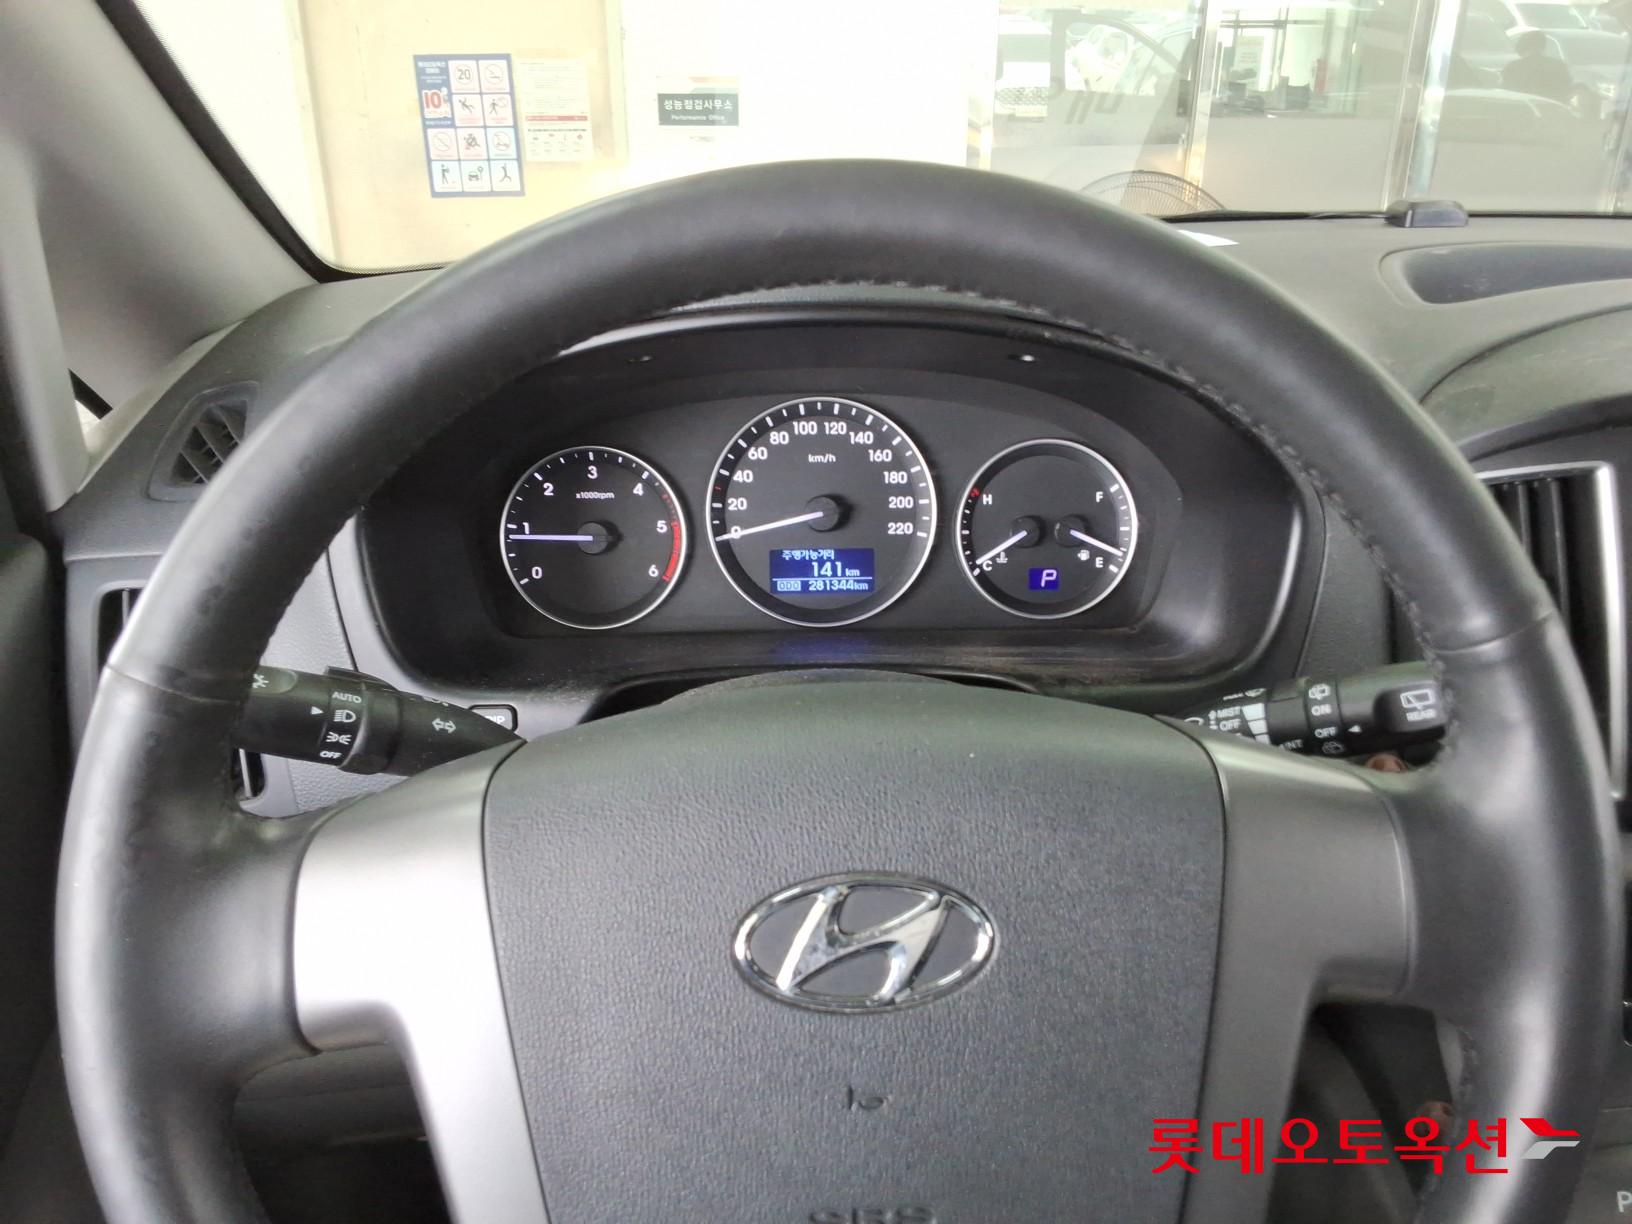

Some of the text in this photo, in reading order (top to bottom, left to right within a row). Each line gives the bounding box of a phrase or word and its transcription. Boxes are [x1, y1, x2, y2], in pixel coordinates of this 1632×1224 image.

[457, 69, 471, 80] 20
[663, 99, 733, 111] 성능점검사무소
[793, 421, 818, 435] 100
[824, 421, 847, 435] 120
[769, 431, 789, 445] 80
[849, 431, 874, 445] 140
[748, 449, 768, 460] 60
[808, 454, 836, 463] km/h
[868, 449, 893, 462] 160
[587, 465, 598, 479] 3
[733, 470, 753, 483] 40
[883, 471, 908, 484] 180
[543, 483, 554, 496] 2
[633, 483, 644, 496] 4
[889, 496, 914, 509] 200
[983, 494, 992, 505] H
[1095, 492, 1104, 503] F
[728, 498, 748, 510] 20
[522, 522, 530, 535] 1
[656, 520, 667, 533] 5
[888, 523, 913, 535] 220
[983, 560, 993, 572] C
[1095, 557, 1103, 568] E
[531, 567, 542, 579] 0
[649, 565, 659, 577] 6
[812, 561, 860, 577] 141 km
[1041, 569, 1057, 587] P
[332, 691, 362, 704] AUTO
[1311, 704, 1332, 716] ON
[1406, 709, 1435, 721] REAR
[1220, 719, 1241, 731] OFF
[1315, 727, 1337, 738] OFF
[319, 750, 342, 760] OFF
